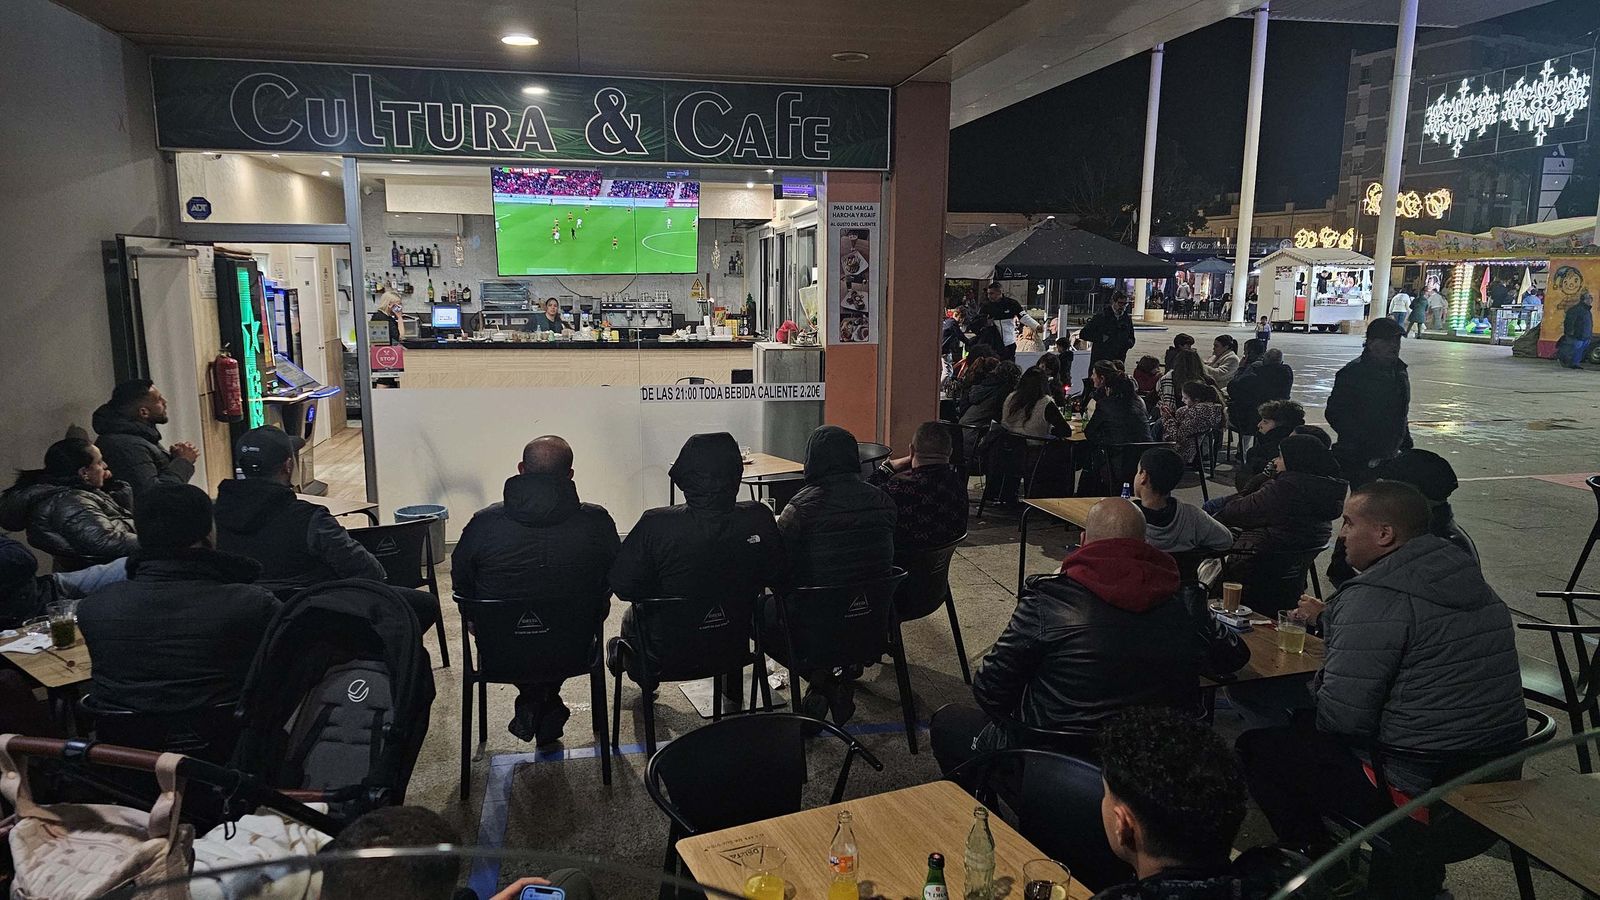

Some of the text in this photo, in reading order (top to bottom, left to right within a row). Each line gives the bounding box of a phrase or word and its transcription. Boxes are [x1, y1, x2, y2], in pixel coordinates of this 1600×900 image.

[585, 87, 649, 155] &
[190, 203, 208, 212] ADT
[1180, 240, 1196, 251] Café
[1197, 240, 1210, 249] Bar
[642, 387, 654, 400] DE
[656, 387, 673, 400] LAS
[675, 387, 697, 400] 21:00
[699, 386, 723, 400] TODA
[724, 386, 756, 399] BEBIDA
[757, 385, 798, 398] CALIENTE
